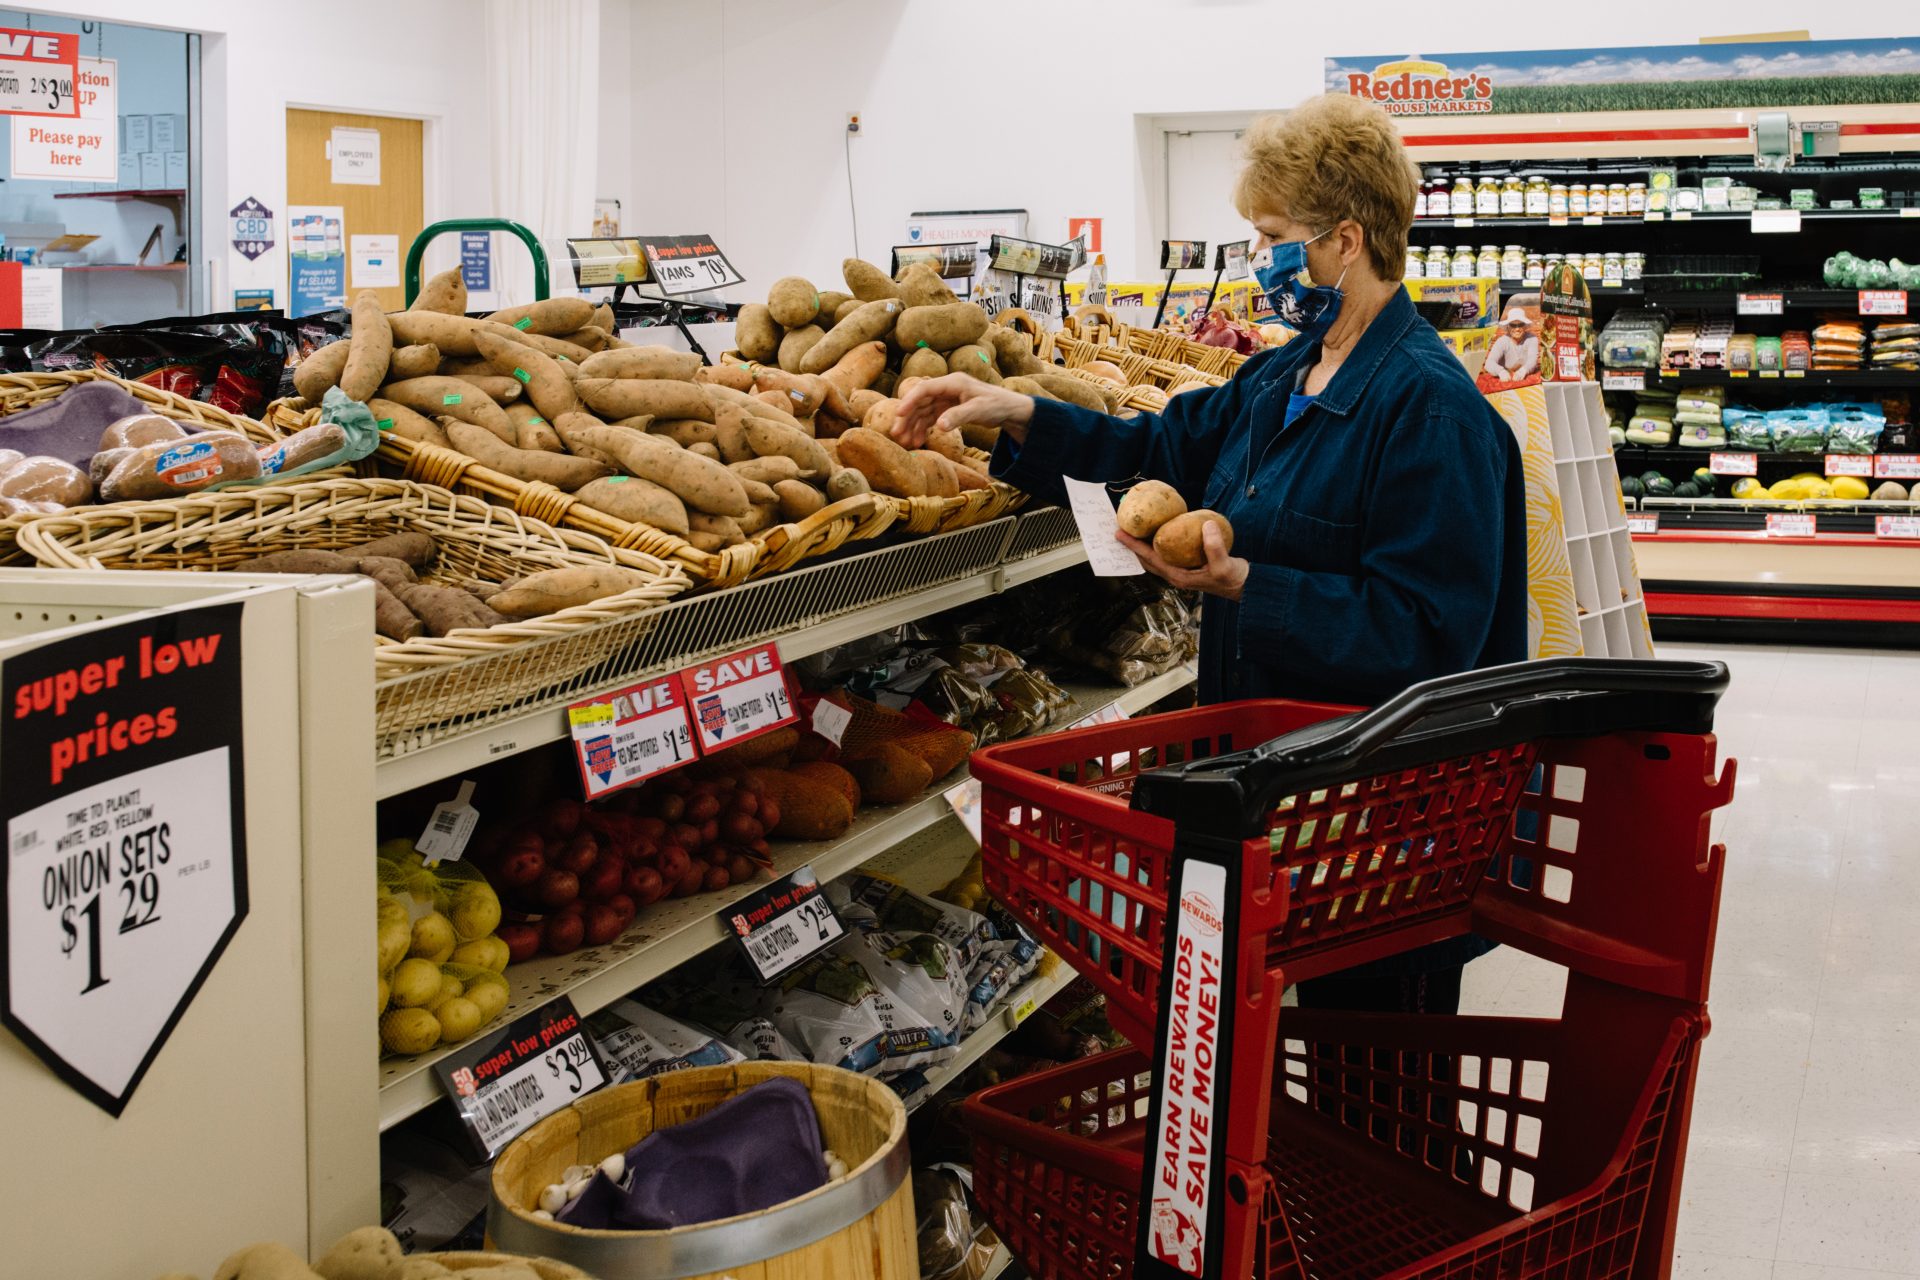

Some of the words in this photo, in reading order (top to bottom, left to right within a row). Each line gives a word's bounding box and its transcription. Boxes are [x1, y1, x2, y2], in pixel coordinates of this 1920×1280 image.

[1348, 72, 1491, 101] Redner's
[1429, 101, 1492, 112] MARKETS
[29, 128, 74, 145] Please
[77, 134, 102, 149] pay
[51, 151, 82, 165] here
[338, 150, 373, 159] EMPLOYEES
[348, 159, 364, 168] ONLY
[236, 219, 268, 234] CBD
[924, 229, 958, 240] HEALTH
[961, 228, 1007, 239] MONITOR
[308, 277, 336, 286] SELLING
[657, 265, 695, 281] YAMS
[1251, 286, 1261, 295] 20
[1559, 346, 1577, 356] SAVE
[14, 655, 125, 719] super
[139, 634, 222, 679] low
[613, 683, 674, 722] AVE
[702, 710, 721, 724] LOW
[704, 718, 728, 733] PRICE!
[51, 706, 178, 785] prices
[590, 750, 612, 764] LOW
[590, 761, 618, 776] PRICE!
[66, 810, 88, 829] TIME
[90, 803, 104, 820] TO
[115, 804, 155, 830] YELLOW
[43, 841, 110, 911] ONION
[119, 822, 171, 877] SETS
[178, 862, 197, 878] PER
[199, 859, 211, 871] LB
[747, 903, 773, 925] super
[770, 895, 791, 910] low
[1181, 898, 1223, 933] REWARDS
[1169, 934, 1194, 1098] REWARDS
[1192, 950, 1220, 1106] MONEY!
[451, 1066, 474, 1084] 50
[475, 1048, 514, 1079] super
[512, 1039, 540, 1058] low
[540, 1013, 578, 1047] prices
[891, 1031, 929, 1046] WHITE
[509, 1073, 545, 1112] POTATOES
[1162, 1100, 1182, 1191] EARN
[1186, 1107, 1209, 1209] SAVE
